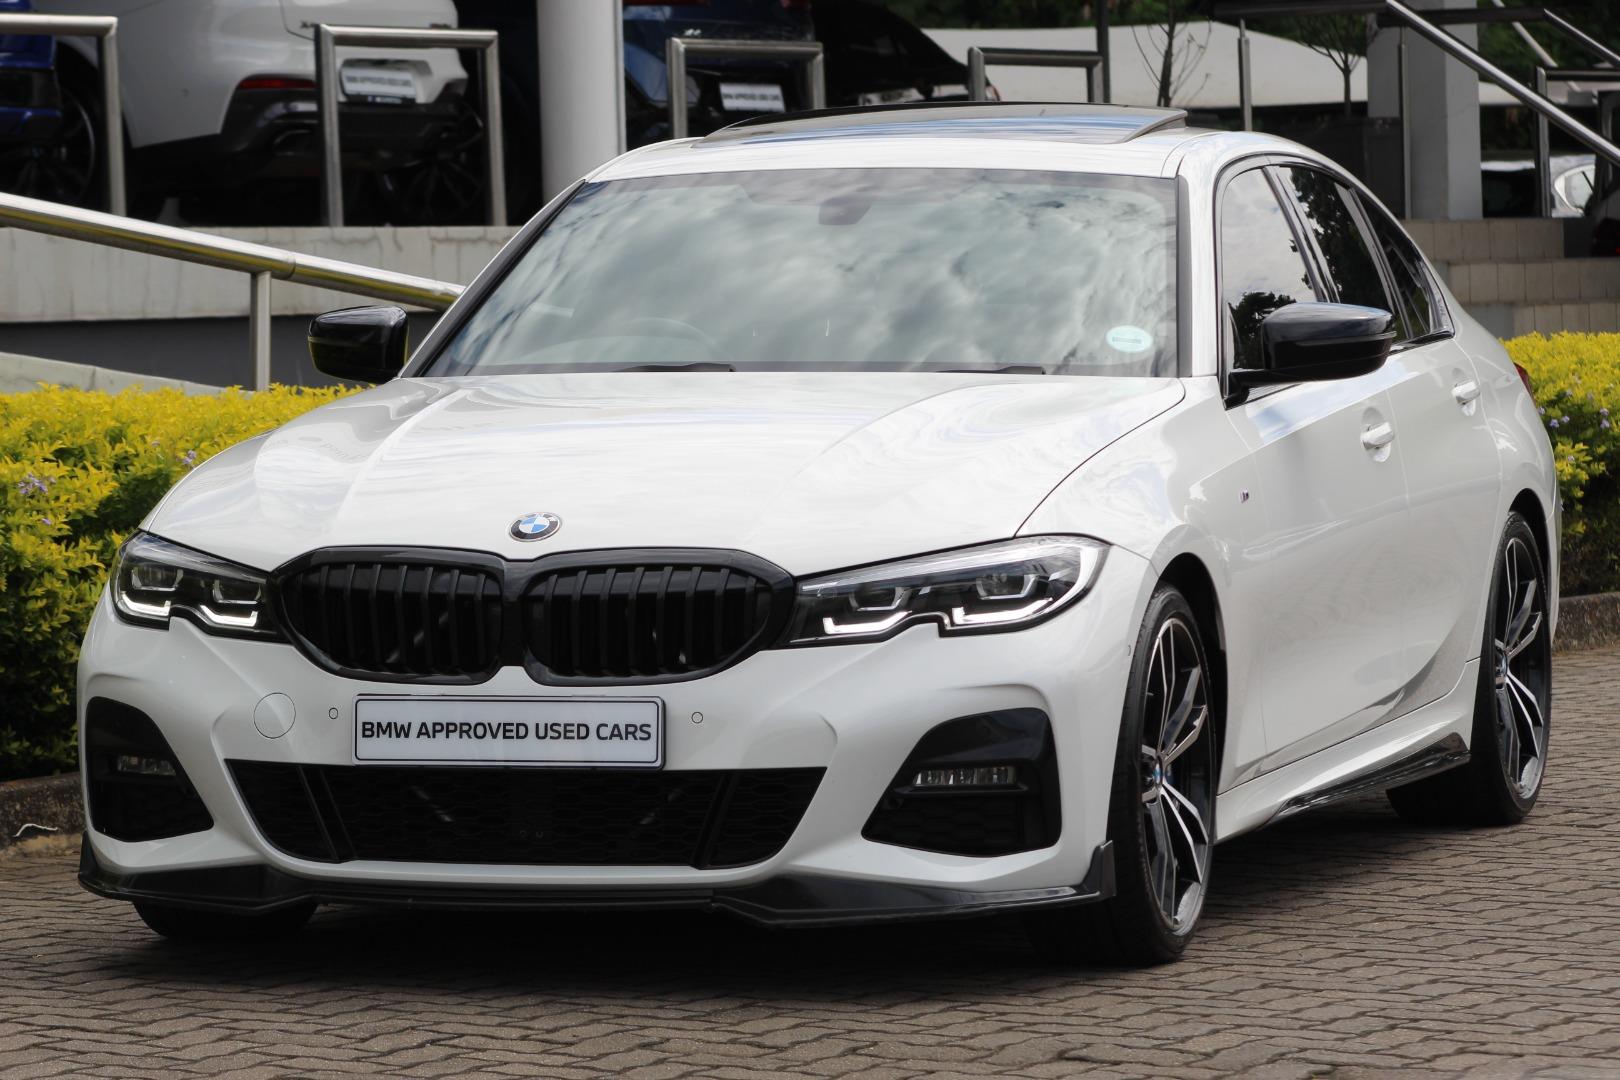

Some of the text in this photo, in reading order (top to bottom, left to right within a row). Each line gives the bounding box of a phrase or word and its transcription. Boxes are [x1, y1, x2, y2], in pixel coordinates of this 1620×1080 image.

[361, 721, 652, 741] BMW APPROVED USED CARS
